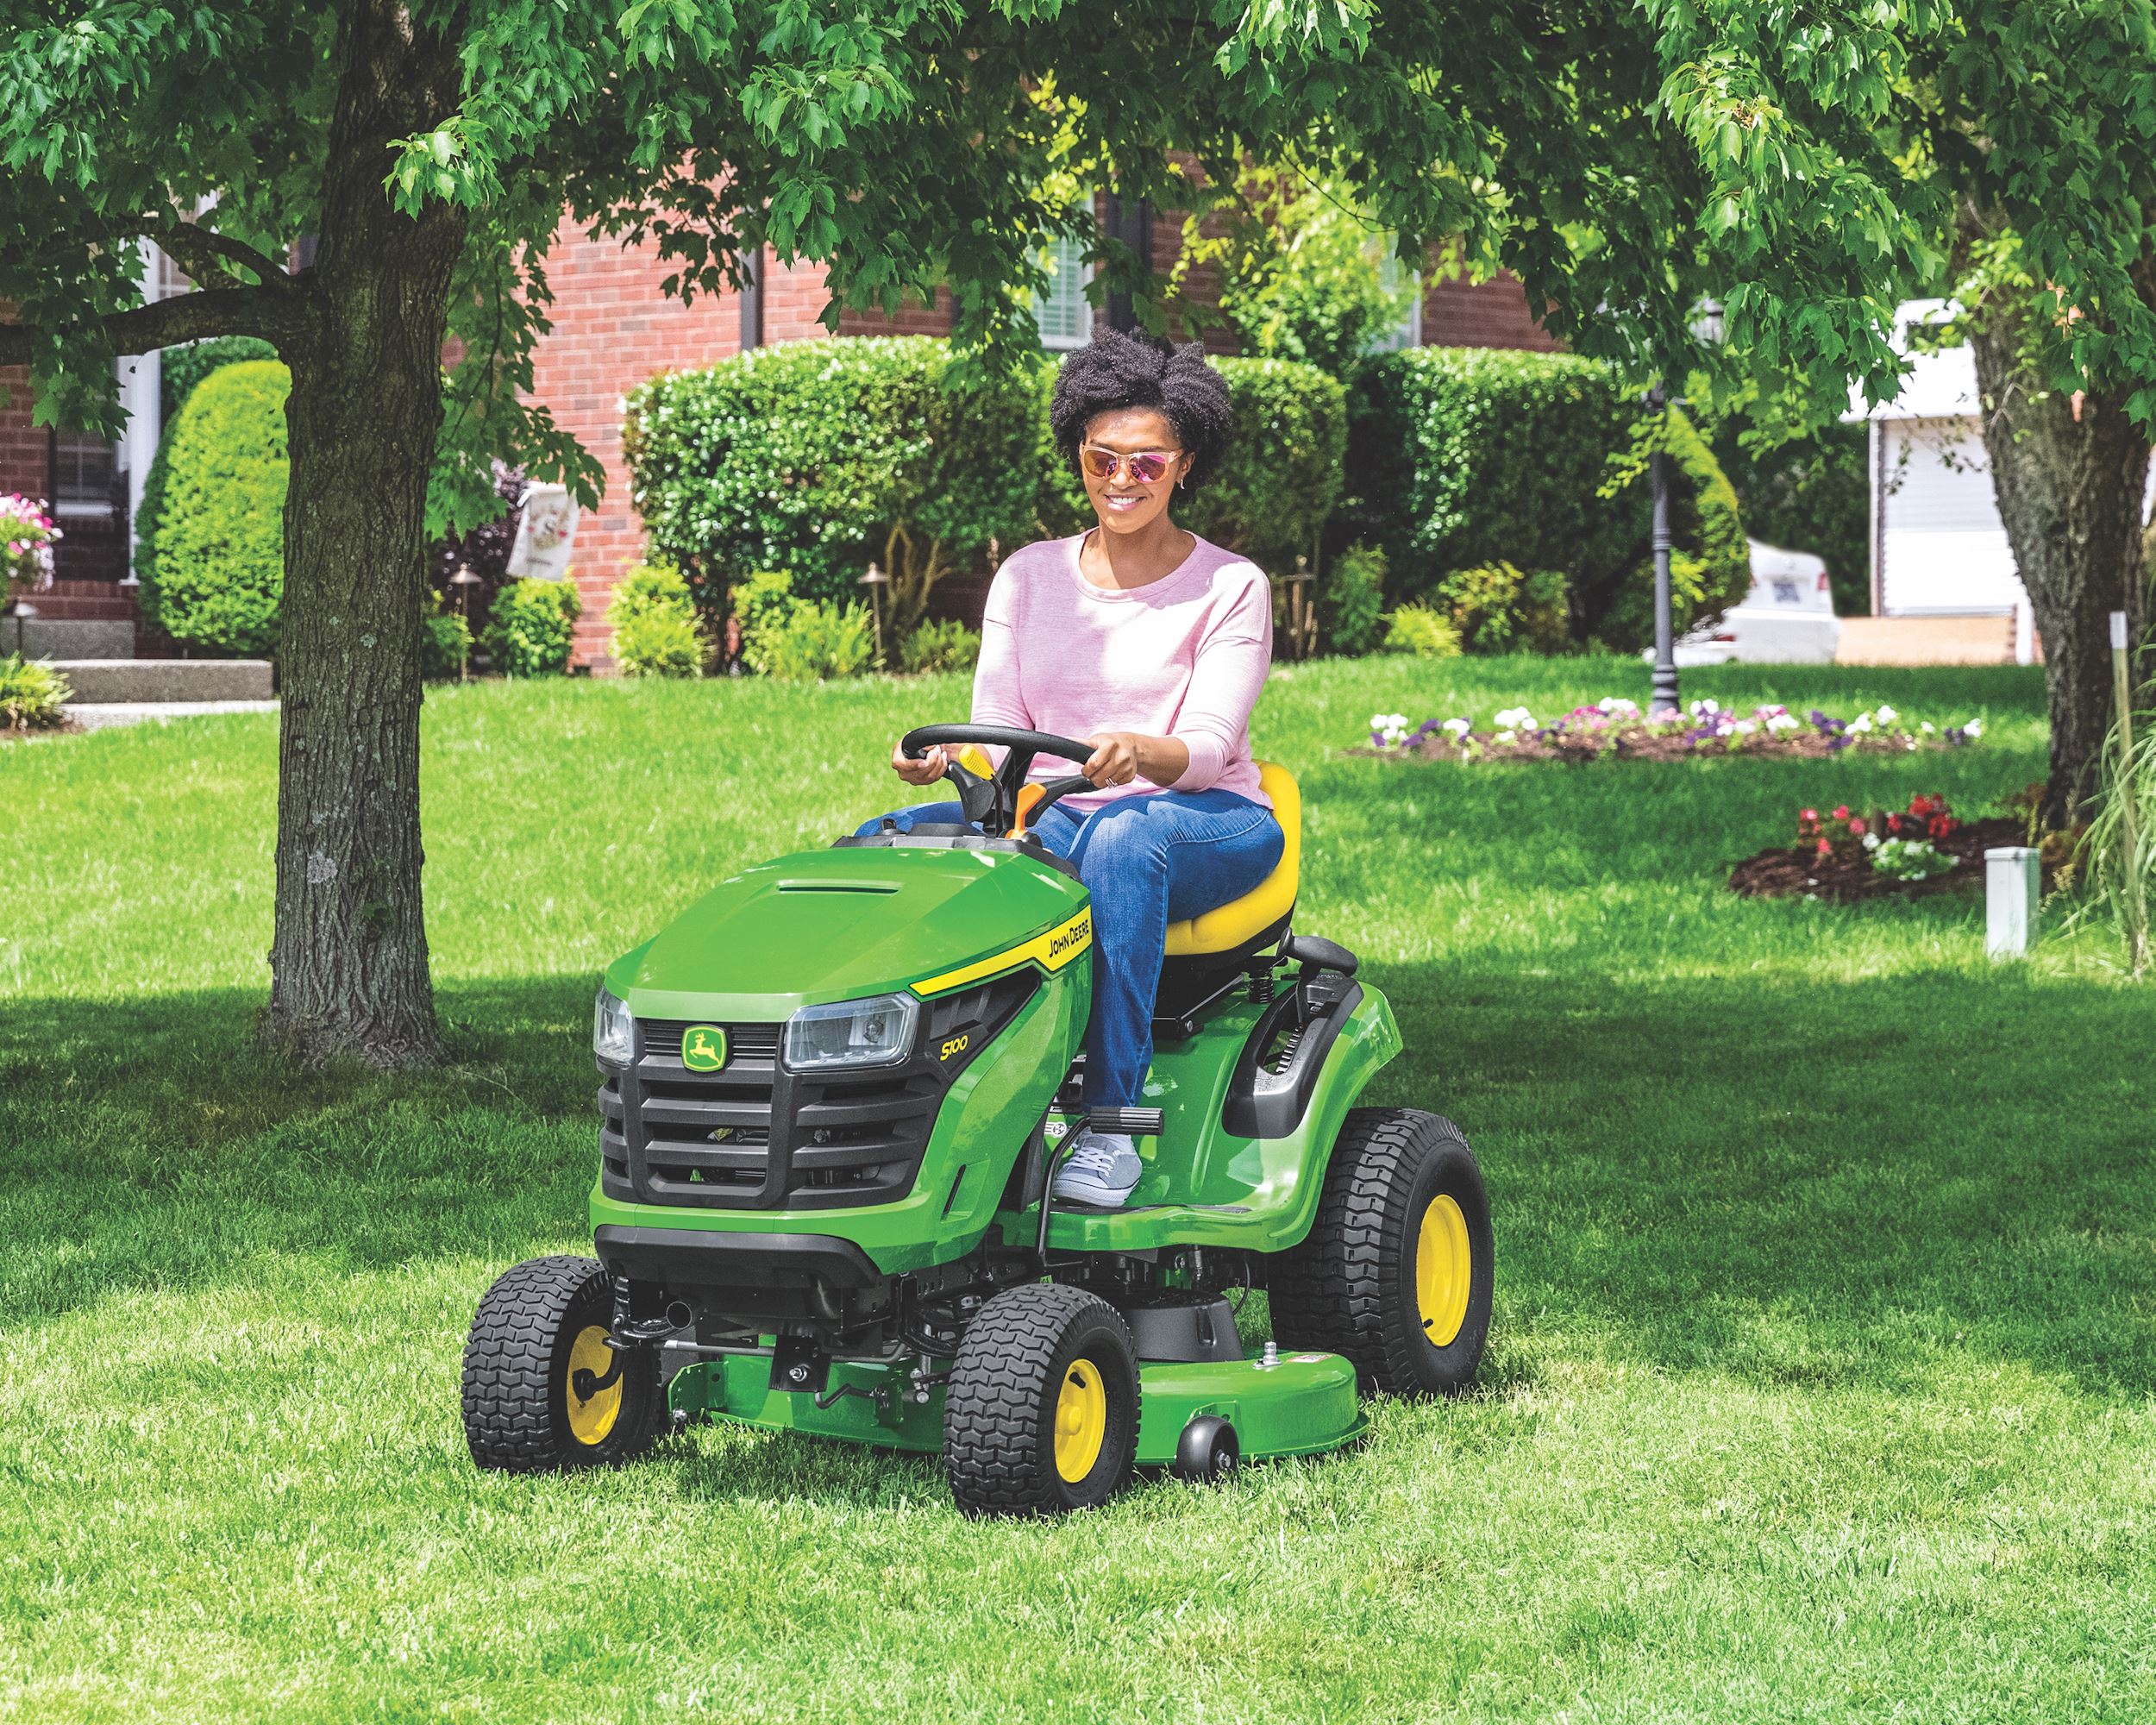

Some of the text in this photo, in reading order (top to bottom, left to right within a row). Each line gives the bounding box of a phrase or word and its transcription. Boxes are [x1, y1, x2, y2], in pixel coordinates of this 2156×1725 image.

[1049, 919, 1089, 957] JOHN DEERE
[940, 1035, 968, 1061] S100
